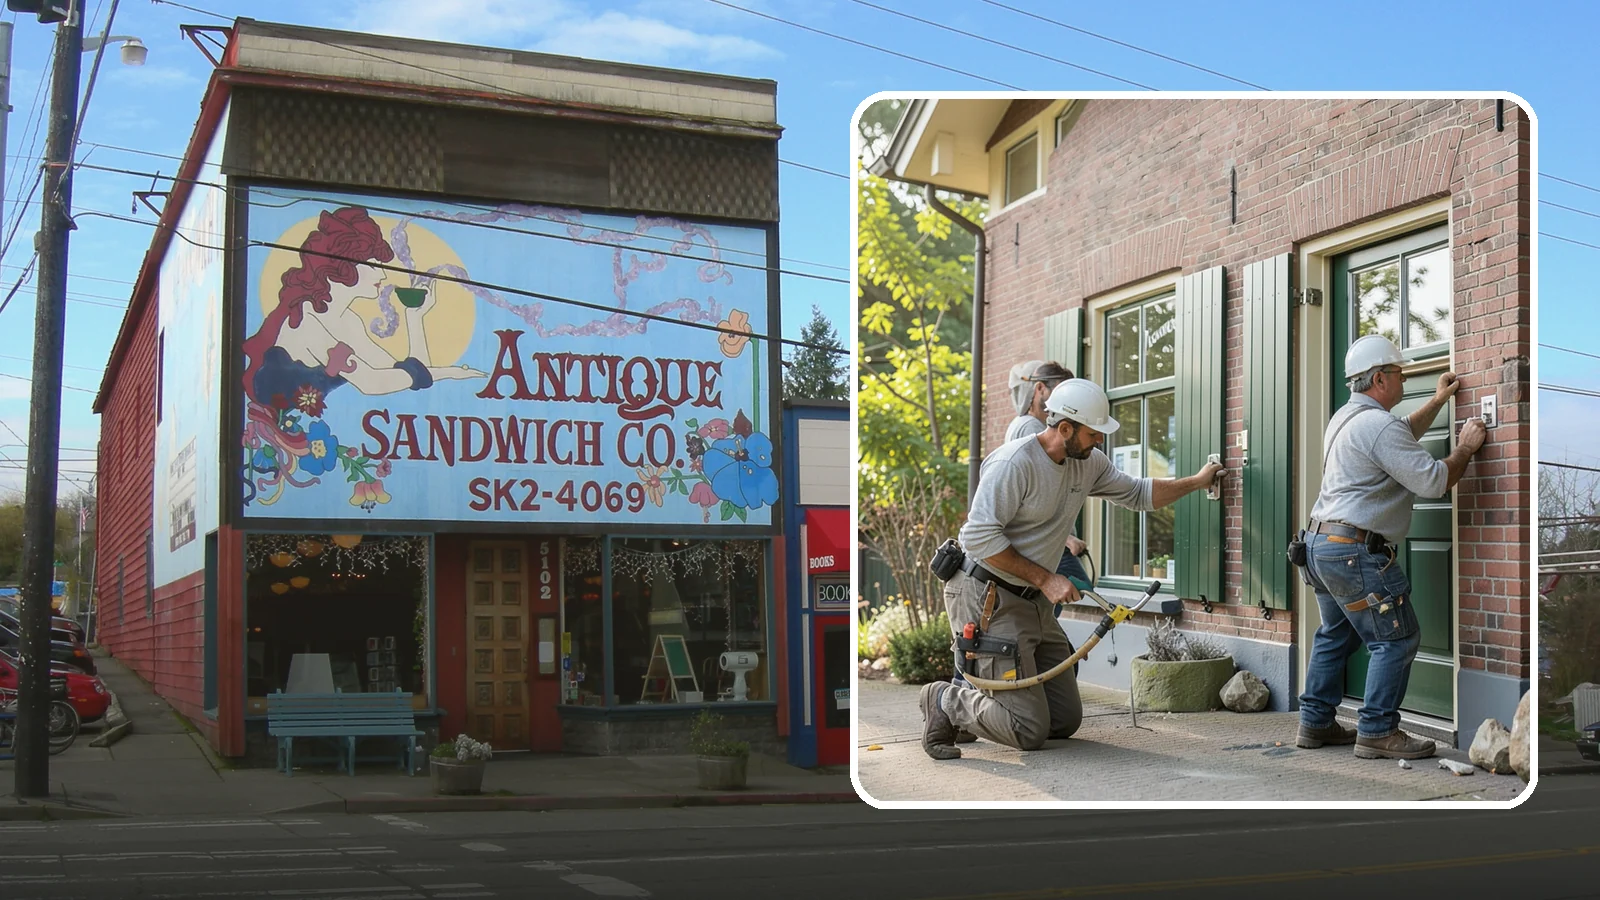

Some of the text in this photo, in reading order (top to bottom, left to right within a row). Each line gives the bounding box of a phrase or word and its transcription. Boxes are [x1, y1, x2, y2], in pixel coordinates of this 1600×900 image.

[475, 329, 724, 420] ANTIQUE
[361, 408, 685, 468] SANDWICH CO.
[468, 477, 646, 513] SK2-4069
[539, 541, 552, 600] 5102
[809, 555, 835, 569] BOOKS
